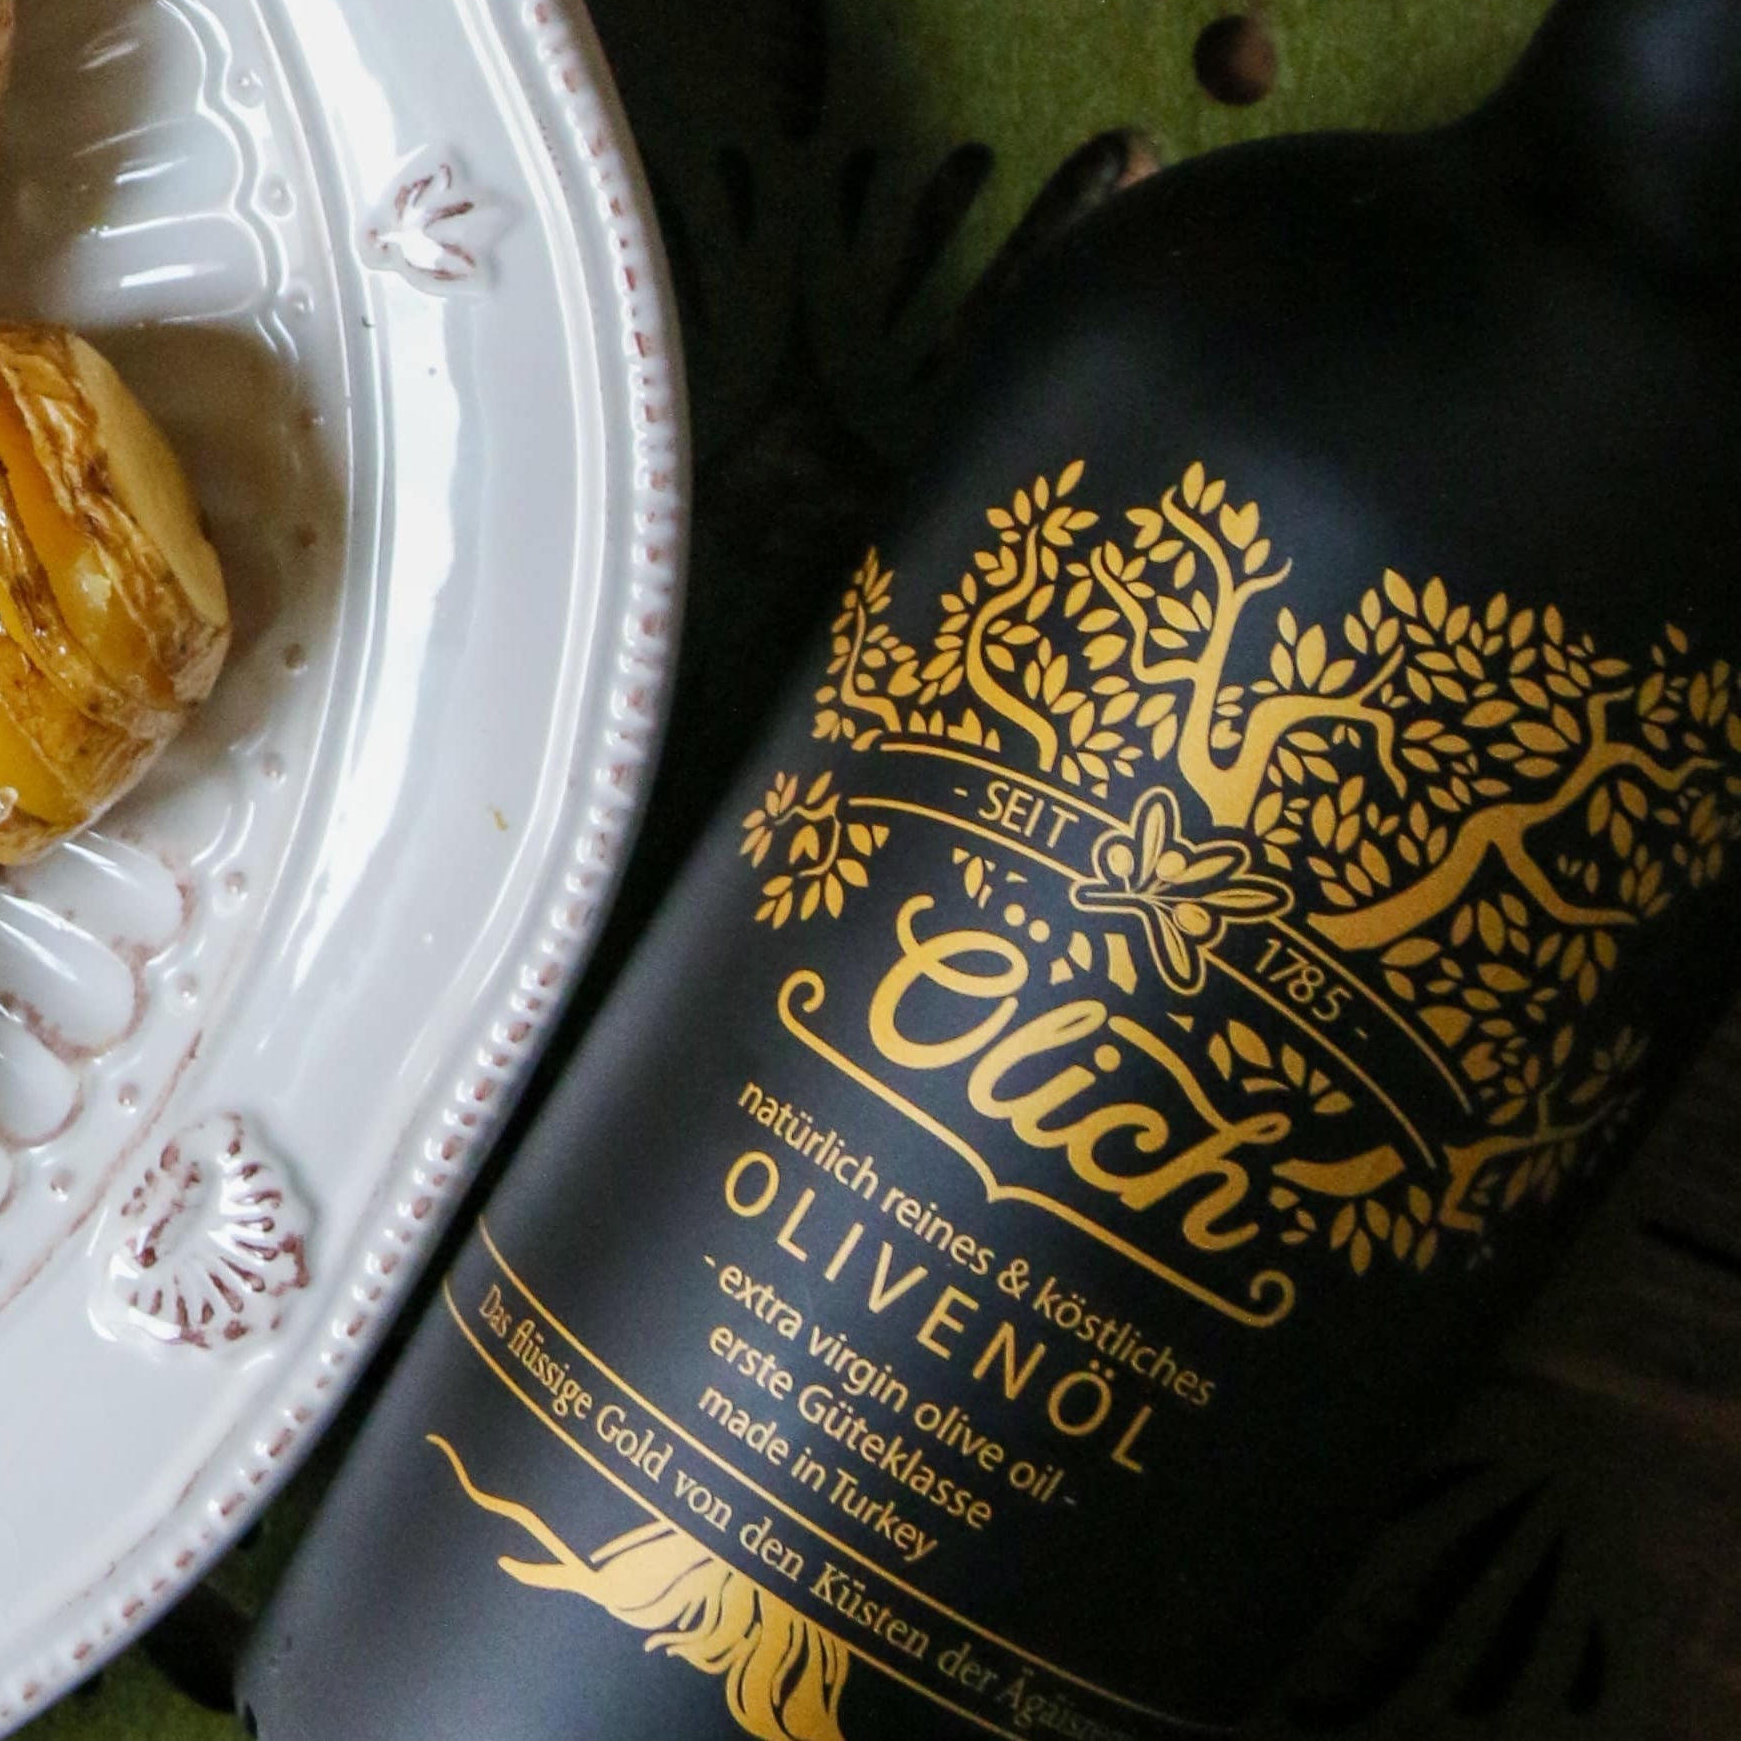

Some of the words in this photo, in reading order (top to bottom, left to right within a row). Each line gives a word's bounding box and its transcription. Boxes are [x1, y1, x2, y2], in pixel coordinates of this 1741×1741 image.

[978, 781, 1080, 849] SEIT
[1253, 938, 1353, 1022] 1785
[868, 895, 1292, 1251] Ölich
[718, 1264, 804, 1341] extra
[809, 1325, 909, 1412] virgin
[914, 1401, 1006, 1471] olive
[1008, 1458, 1065, 1503] oil
[724, 1150, 1152, 1473] OLIVENÖL
[737, 1081, 880, 1201] natürlich
[880, 1185, 996, 1277] reines
[997, 1258, 1031, 1299] &
[1032, 1276, 1217, 1407] köstliches
[479, 1284, 513, 1338] Das
[507, 1318, 593, 1418] flüssige
[596, 1404, 674, 1483] Gold
[673, 1469, 733, 1532] von
[739, 1515, 805, 1581] den
[808, 1561, 931, 1660] Küsten
[936, 1641, 1000, 1693] der
[698, 1385, 791, 1465] made
[791, 1446, 827, 1492] in
[827, 1467, 939, 1562] Turkey
[709, 1324, 794, 1400] erste
[797, 1384, 994, 1529] Güteklasse
